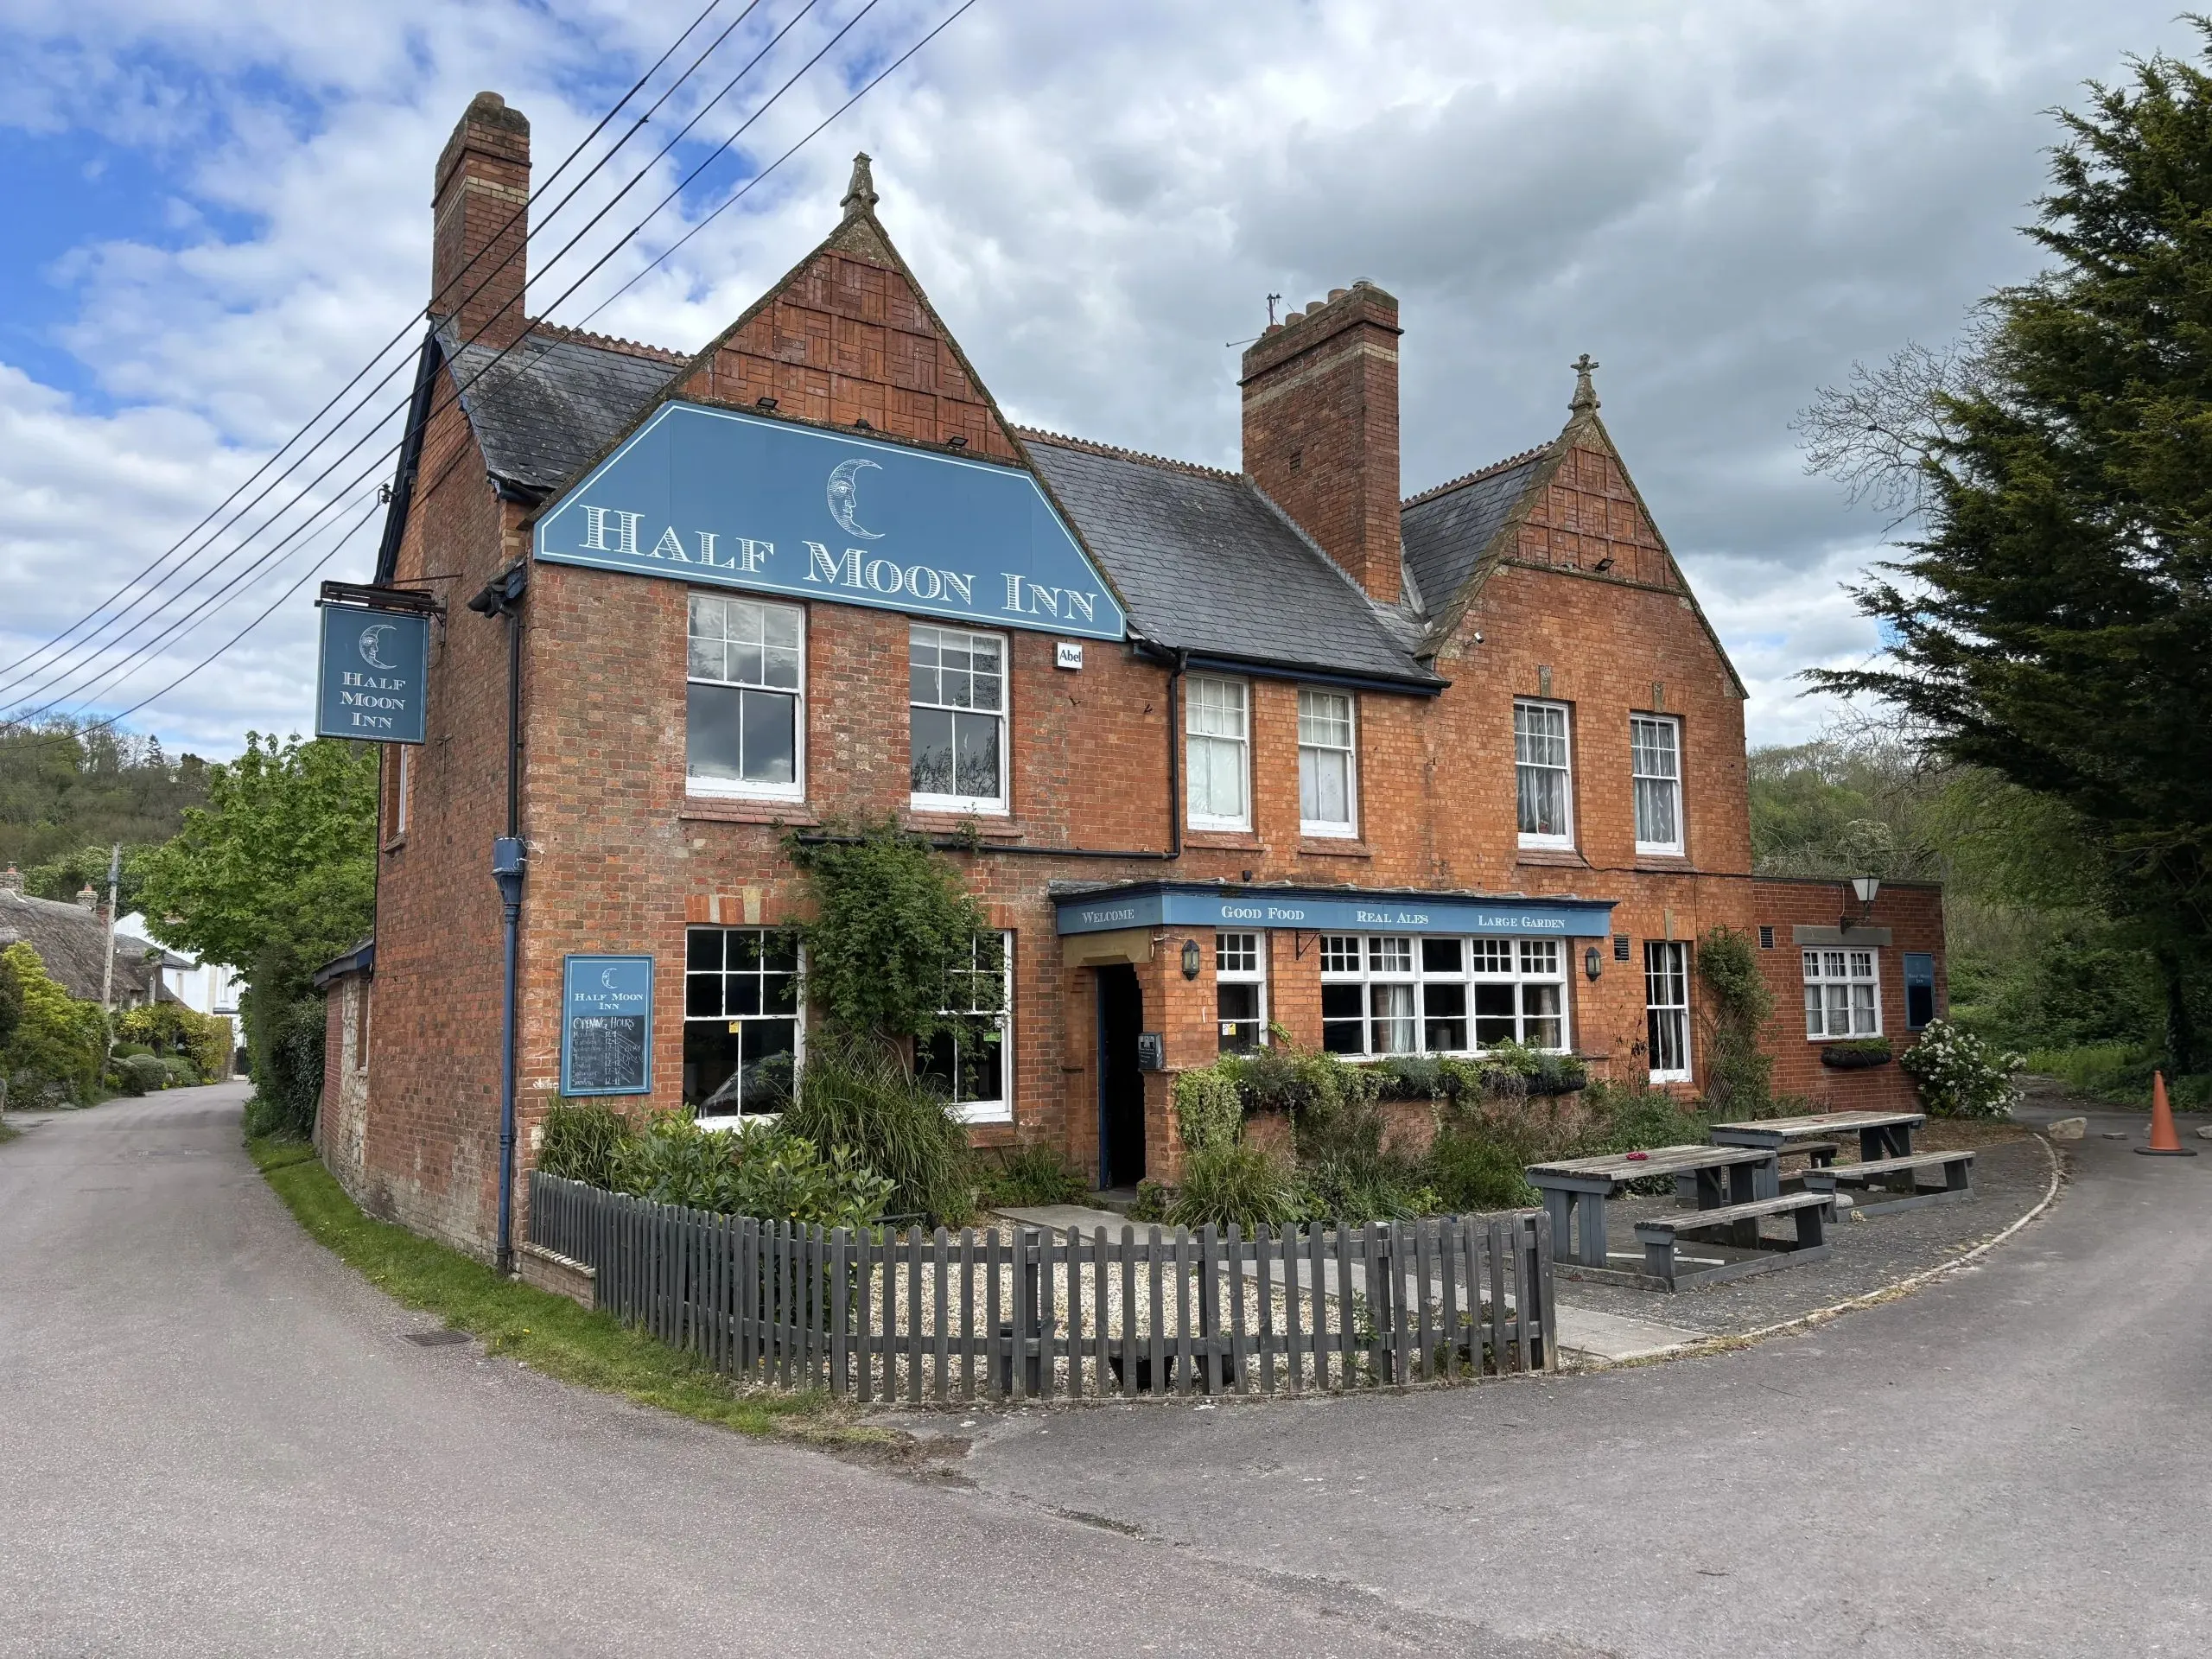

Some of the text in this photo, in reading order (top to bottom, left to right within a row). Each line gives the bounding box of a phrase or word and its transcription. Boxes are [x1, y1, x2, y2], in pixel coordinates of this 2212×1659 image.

[579, 505, 1098, 622] HALF MOON INN
[1059, 649, 1082, 662] Abel
[342, 671, 406, 690] HALF
[340, 691, 406, 710] MOON
[351, 712, 393, 728] INN
[1082, 908, 1135, 924] WELCOME
[1221, 906, 1305, 920] GOOD FOOD
[1357, 910, 1429, 925] REAL ALES
[1478, 915, 1566, 929] LARGE GARDEN
[610, 1016, 635, 1031] HOURS
